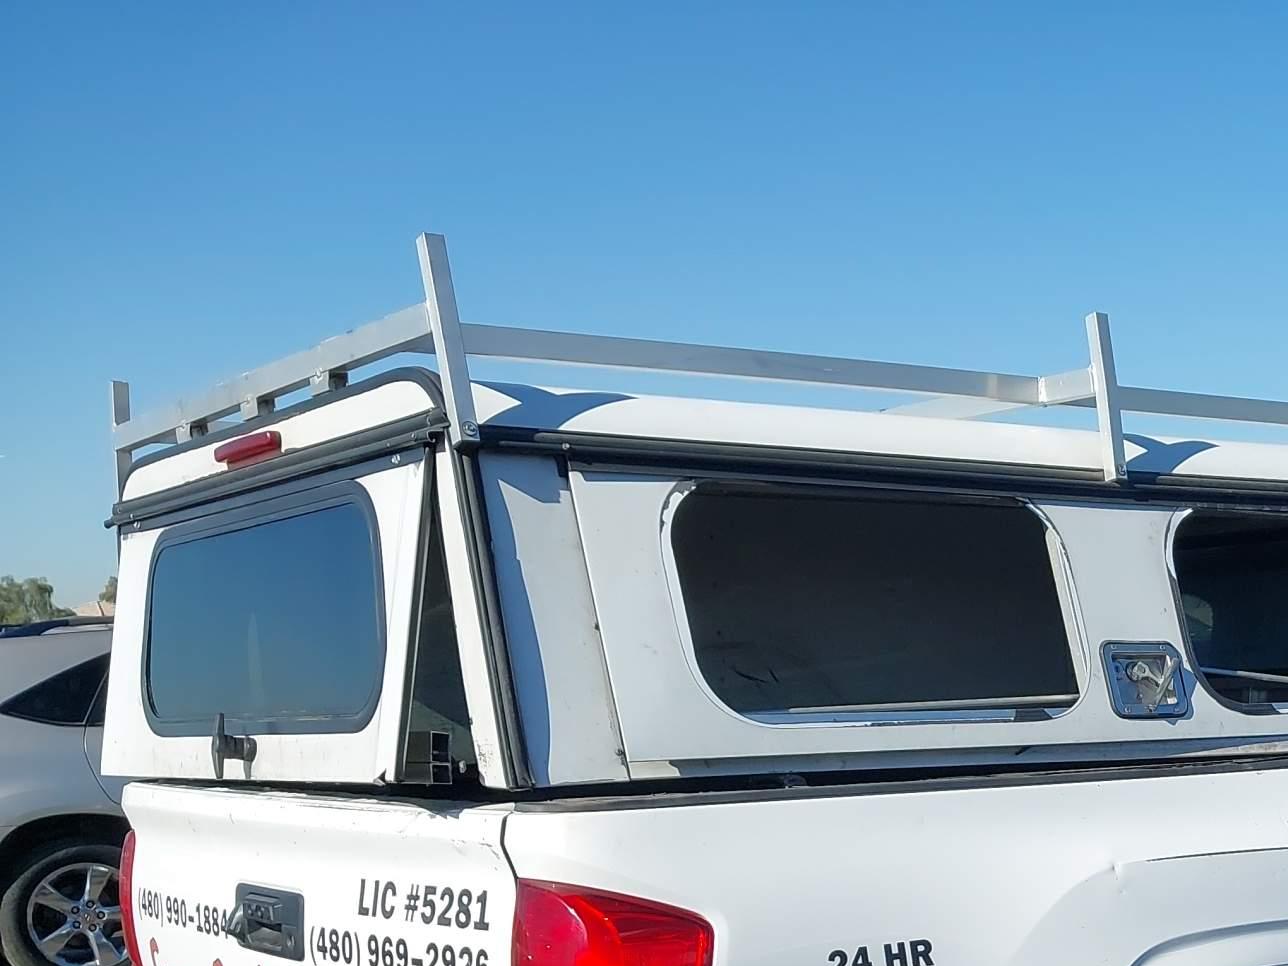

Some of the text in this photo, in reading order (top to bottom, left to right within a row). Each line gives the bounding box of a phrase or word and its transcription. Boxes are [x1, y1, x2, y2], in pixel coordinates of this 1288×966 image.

[138, 888, 230, 939] (480) 990-1884
[357, 878, 490, 931] LIC #5281
